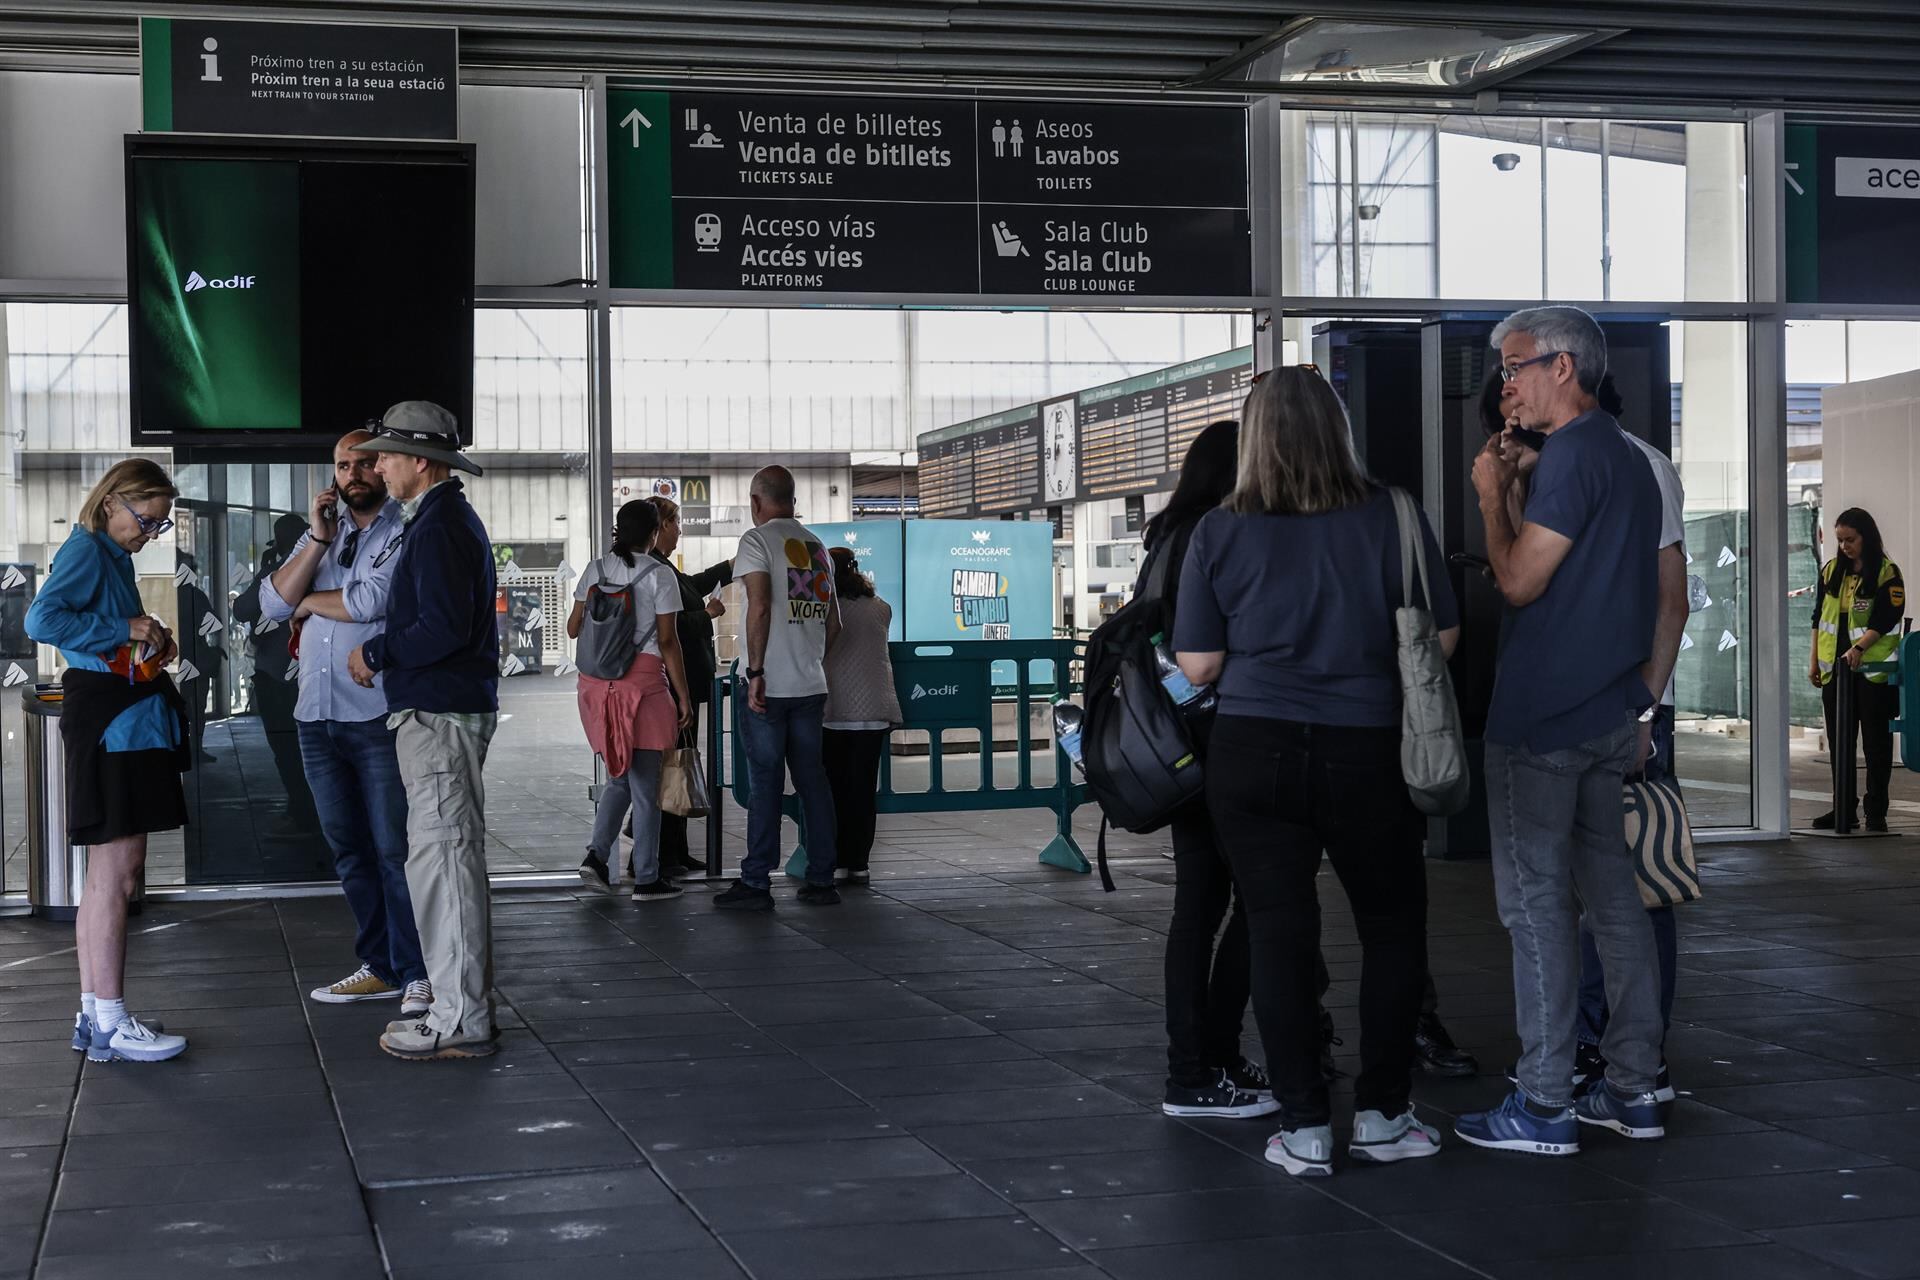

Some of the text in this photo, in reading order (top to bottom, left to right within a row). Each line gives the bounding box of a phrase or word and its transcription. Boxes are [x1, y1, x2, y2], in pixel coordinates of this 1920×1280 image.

[252, 55, 423, 72] Próximo tren a su estación
[252, 72, 444, 90] Pròxim tren a la seua estació
[340, 93, 373, 101] STATION
[739, 111, 941, 136] Venta de billetes
[1036, 120, 1092, 138] Aseos
[739, 141, 951, 166] Venda de bitllets
[1036, 146, 1119, 164] Lavabos
[739, 171, 832, 184] TICKETS SALE
[1037, 178, 1091, 189] TOILETS
[1868, 168, 1920, 188] ace
[742, 215, 875, 238] Acceso vías
[1045, 221, 1147, 243] Sala Club
[741, 243, 862, 267] Accés vies
[1045, 250, 1151, 272] Sala Club
[210, 276, 255, 288] adif
[742, 274, 822, 286] PLATFORMS
[1044, 279, 1135, 291] CLUB LOUNGE
[953, 570, 998, 598] CAMBIA
[954, 597, 963, 613] EL
[964, 598, 1008, 627] CAMBIO
[519, 632, 534, 648] NX
[928, 685, 958, 695] adif
